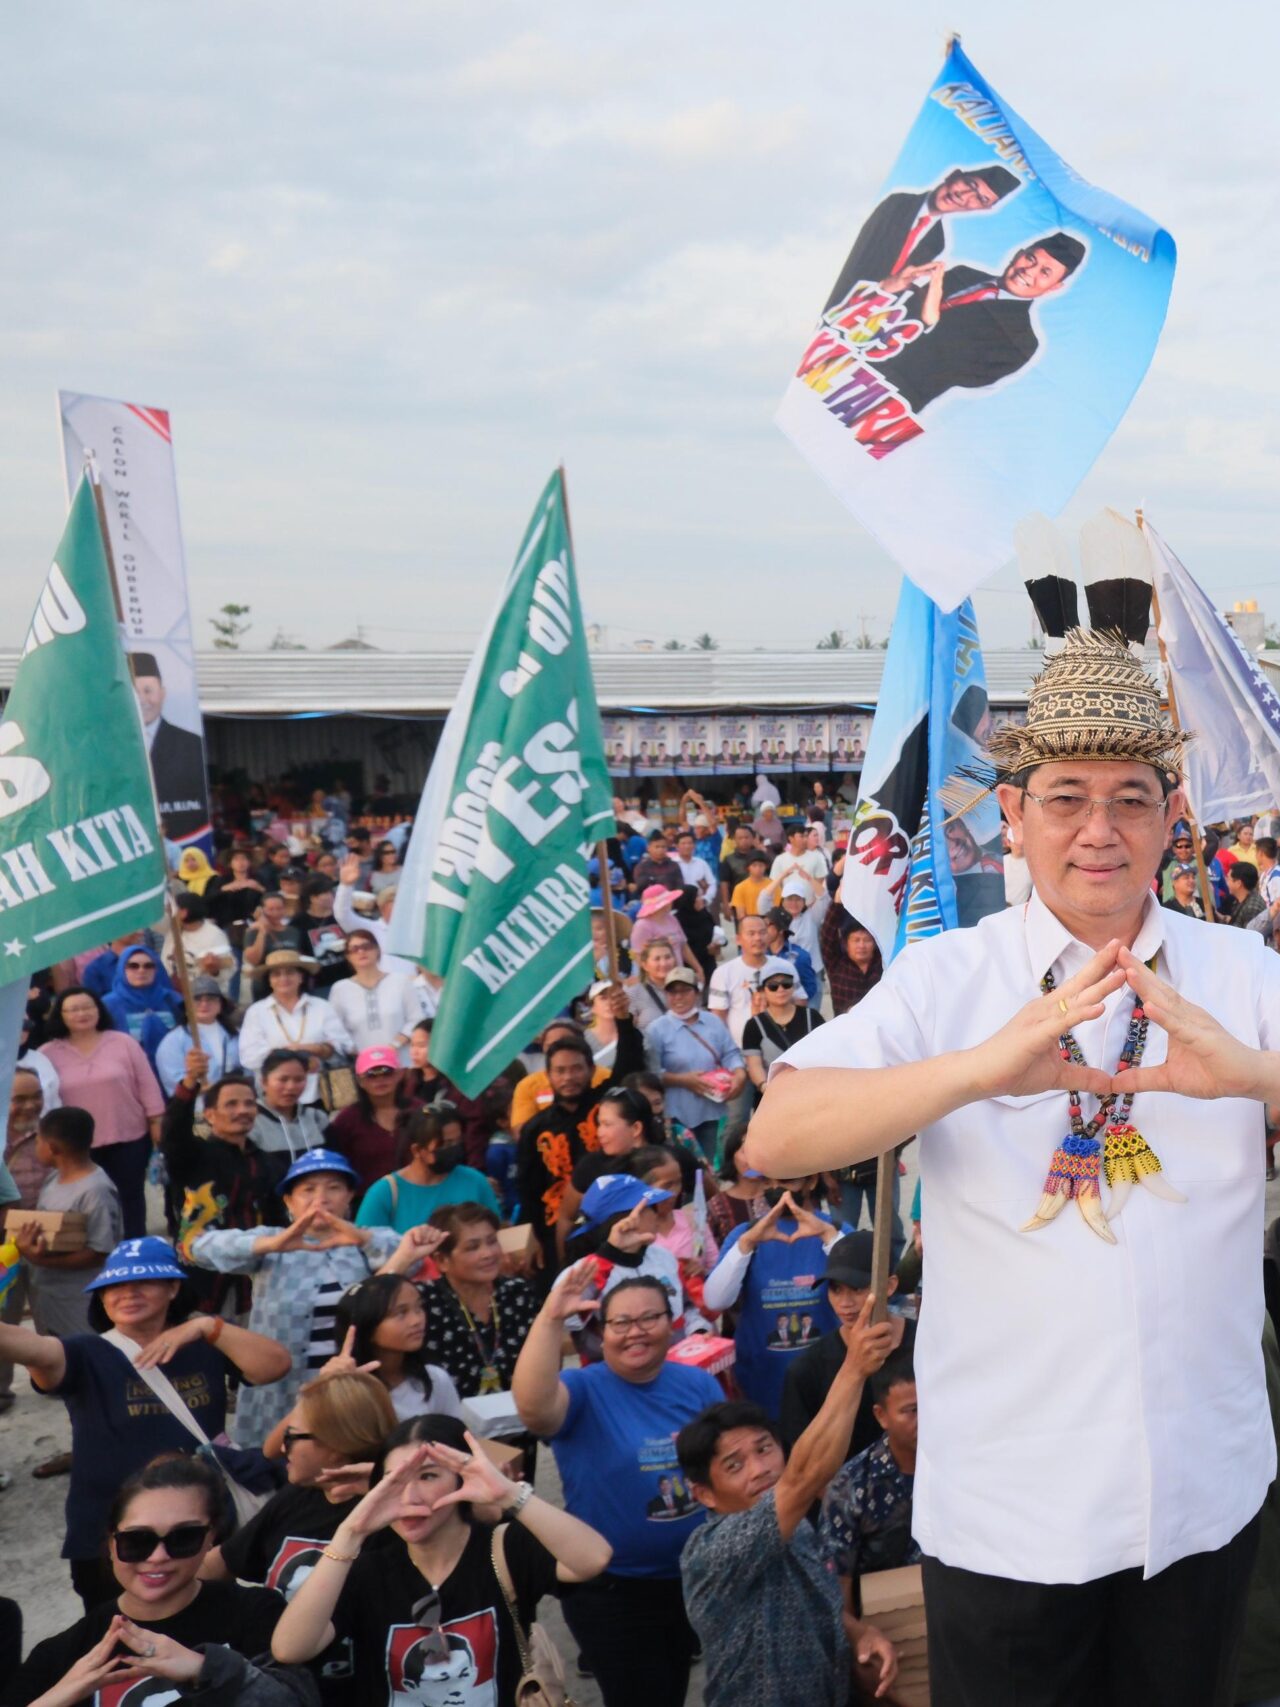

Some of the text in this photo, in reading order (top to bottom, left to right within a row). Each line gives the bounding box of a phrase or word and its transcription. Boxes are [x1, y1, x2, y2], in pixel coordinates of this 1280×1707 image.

[112, 425, 143, 635] CALON WAKIL GUBERNUR
[47, 804, 154, 883] KITA
